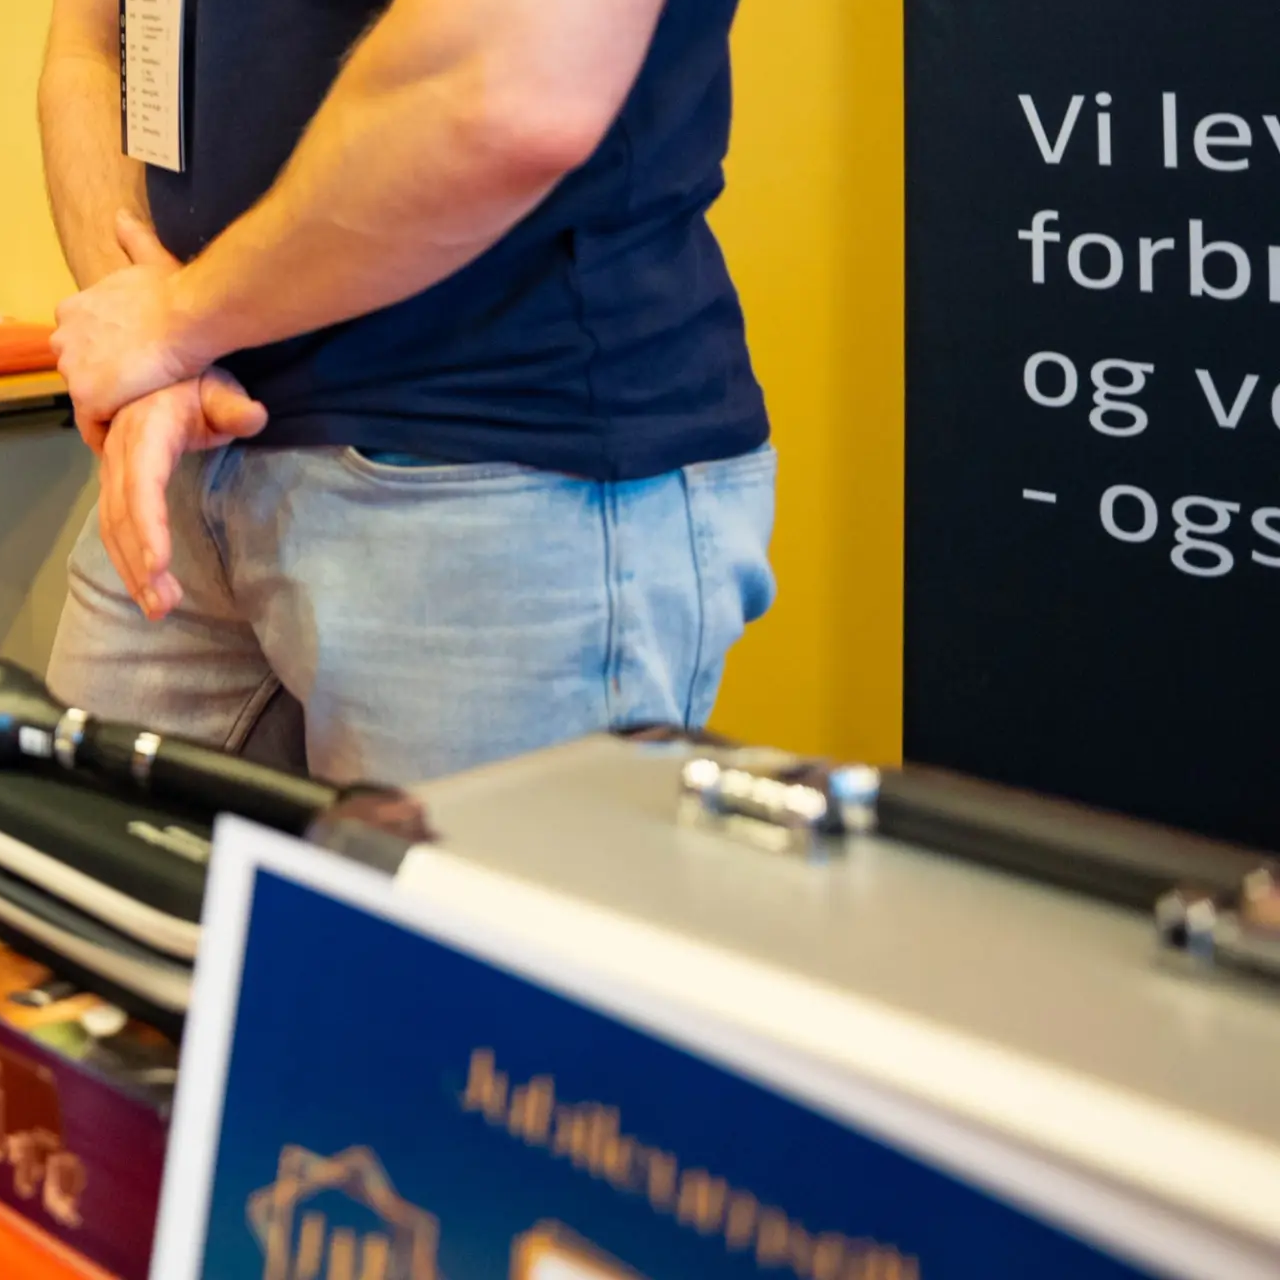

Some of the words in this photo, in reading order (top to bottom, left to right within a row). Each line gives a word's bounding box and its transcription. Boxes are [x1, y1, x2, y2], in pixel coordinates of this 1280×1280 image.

[1017, 91, 1113, 166] Vi
[1022, 350, 1155, 437] og
[1194, 368, 1280, 430] v
